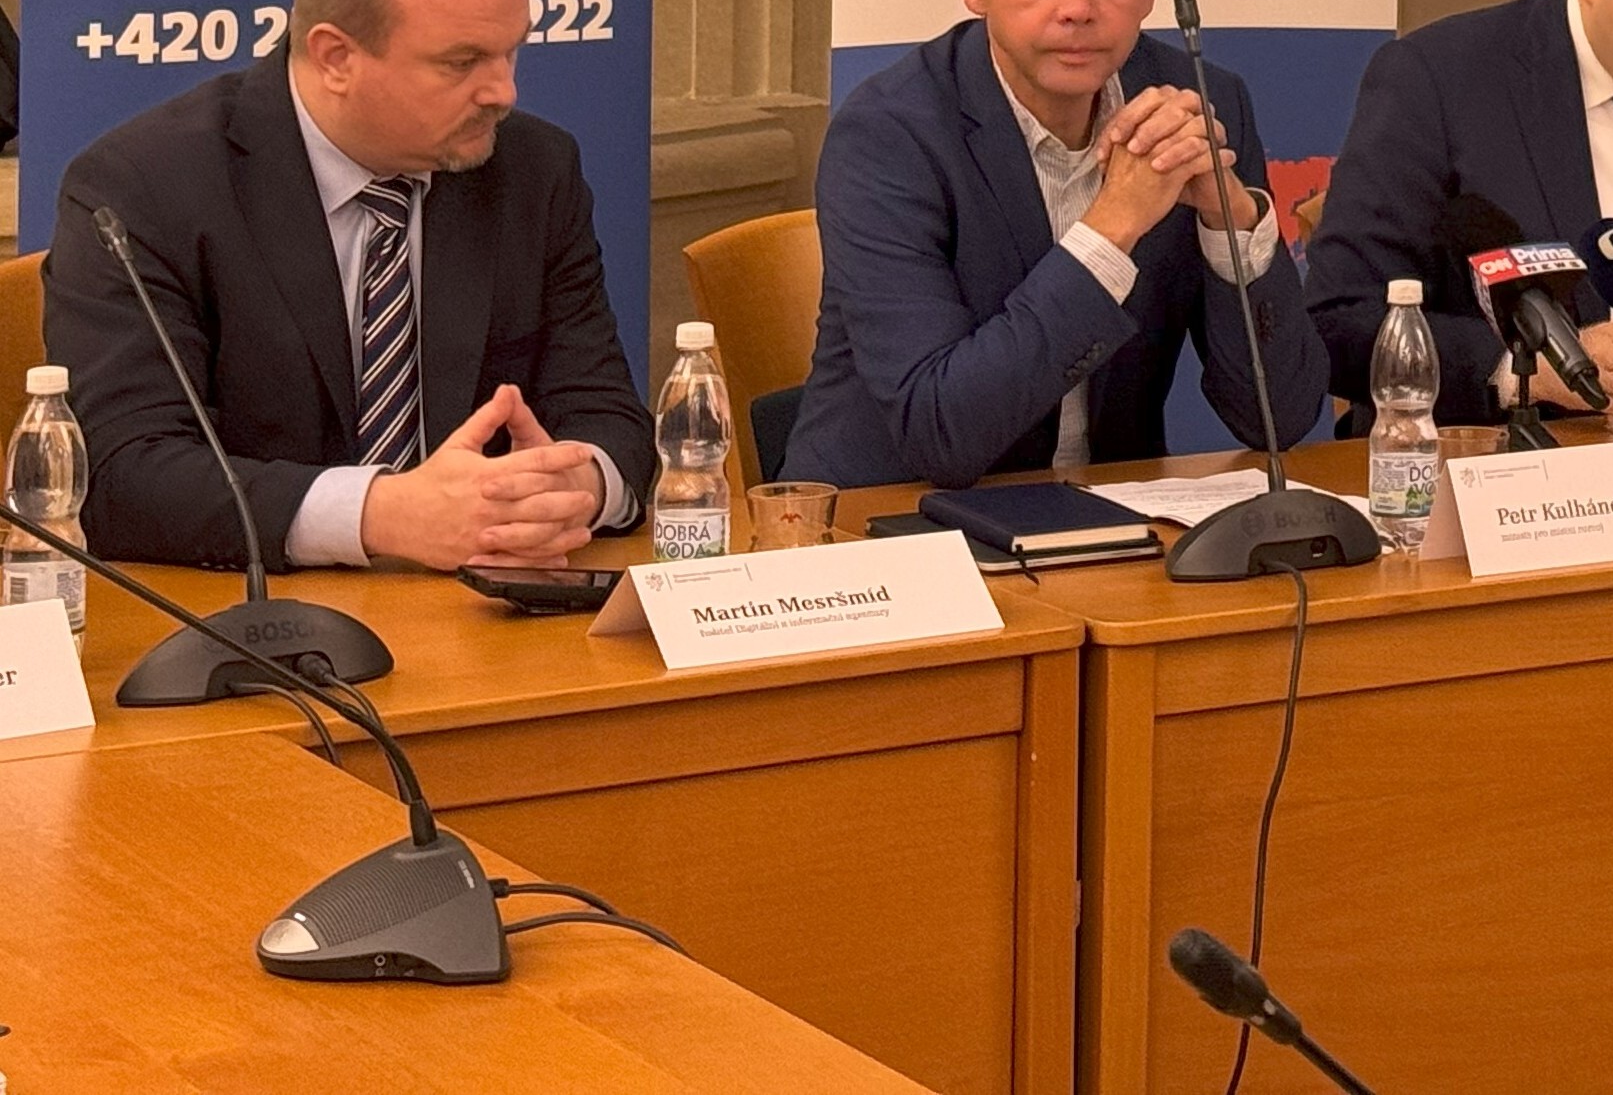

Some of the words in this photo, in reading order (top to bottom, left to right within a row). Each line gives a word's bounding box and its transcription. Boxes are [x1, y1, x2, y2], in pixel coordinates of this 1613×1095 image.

[76, 10, 239, 65] +420
[1510, 247, 1576, 265] Prima
[1525, 260, 1581, 274] NEWS
[1496, 505, 1538, 526] Petr
[690, 599, 774, 625] Martin
[776, 585, 893, 614] Mesršmíd
